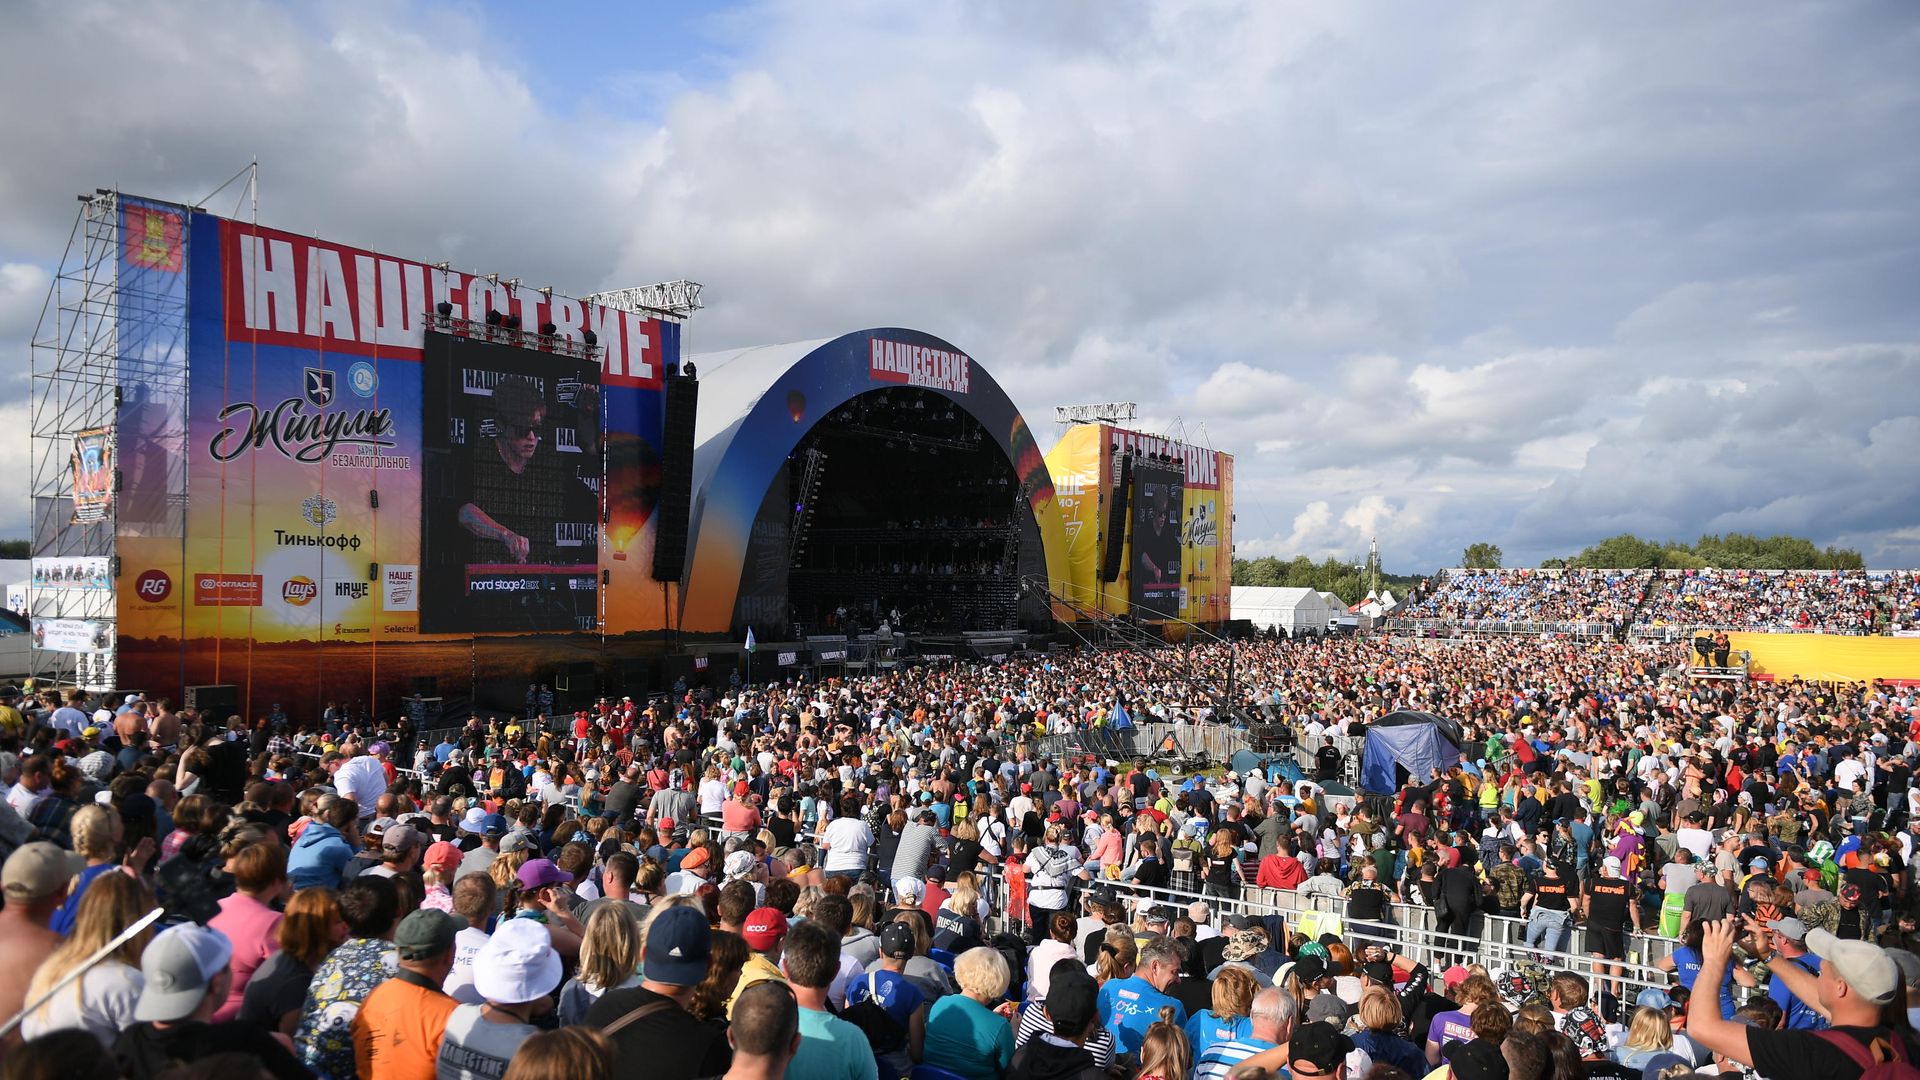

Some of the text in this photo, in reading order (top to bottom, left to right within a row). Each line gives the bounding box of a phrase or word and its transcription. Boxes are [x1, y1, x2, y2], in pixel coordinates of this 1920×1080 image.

[240, 234, 653, 379] НАШЕСТВИЕ
[872, 339, 969, 383] НАШЕСТВИЕ
[209, 398, 396, 464] Жигули
[332, 454, 410, 469] БЕЗАЛКОГОЛЬНОЕ
[274, 530, 361, 551] Тинькофф
[389, 571, 413, 581] НАШЕ
[141, 579, 166, 595] RG
[215, 580, 258, 588] СОГЛАСИЕ
[336, 582, 369, 596] НАШЕ
[471, 579, 493, 590] nord
[384, 625, 417, 633] Selectel
[1601, 885, 1624, 895] СКУЧАЙ
[746, 924, 768, 932] ecco
[936, 915, 964, 937] RUSSIA
[442, 1043, 504, 1078] НАШЕСТВИЕ
